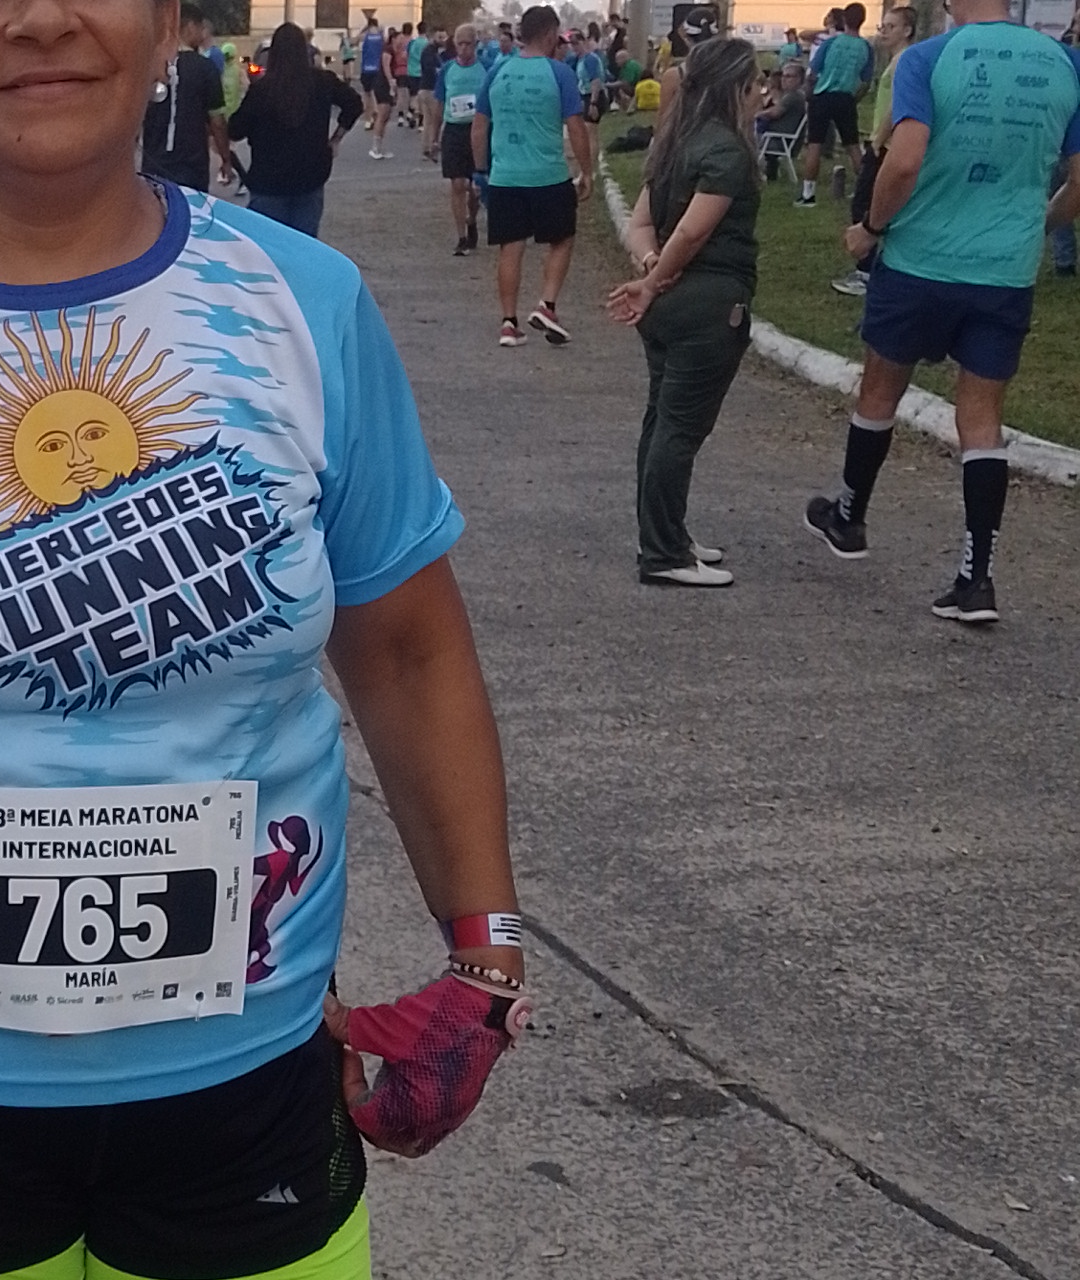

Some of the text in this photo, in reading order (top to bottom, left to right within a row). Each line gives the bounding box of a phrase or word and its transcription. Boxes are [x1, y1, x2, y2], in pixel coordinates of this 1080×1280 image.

[35, 561, 265, 692] TEAM
[20, 808, 73, 828] MEIA
[80, 804, 200, 826] MARATONA
[2, 837, 177, 860] INTERNACIONAL
[8, 874, 169, 964] 765
[65, 967, 119, 988] MARÍA
